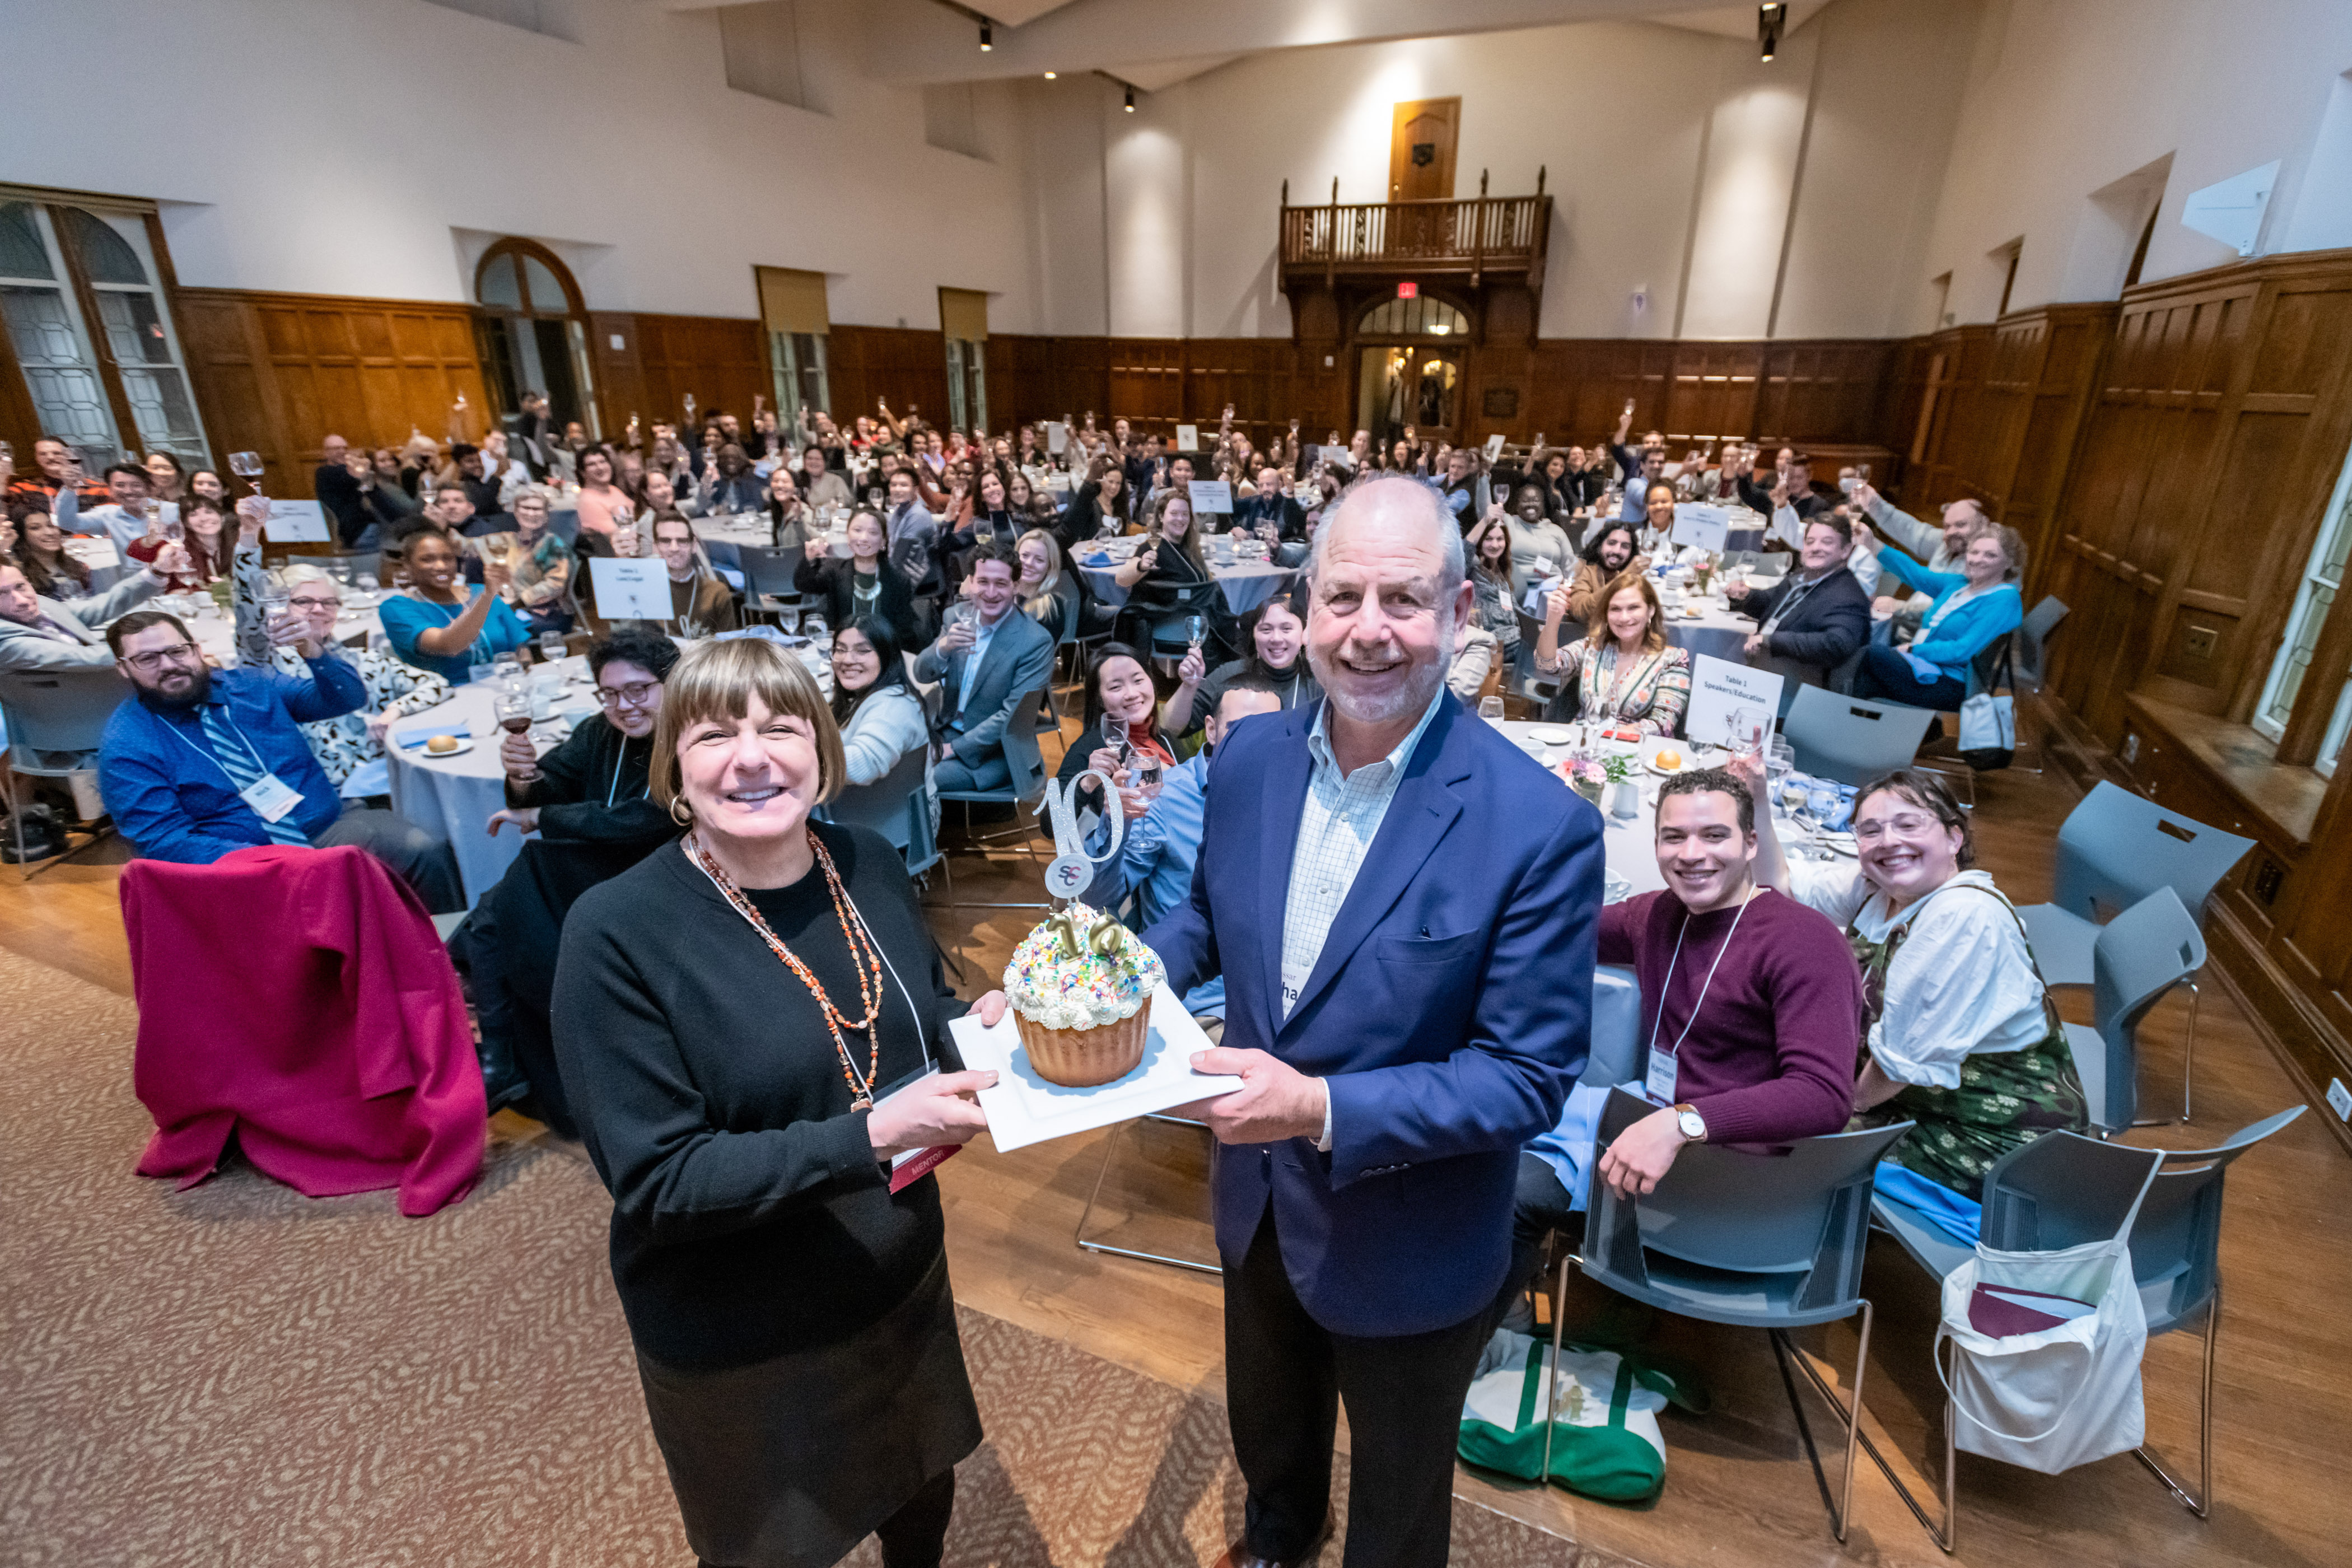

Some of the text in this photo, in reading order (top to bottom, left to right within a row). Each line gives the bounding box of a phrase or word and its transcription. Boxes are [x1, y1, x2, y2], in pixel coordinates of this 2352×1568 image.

[1725, 675, 1742, 685] Table
[1704, 681, 1766, 704] Speakers/Education
[1651, 1063, 1674, 1081] Harrison
[911, 1149, 945, 1175] MENTOR
